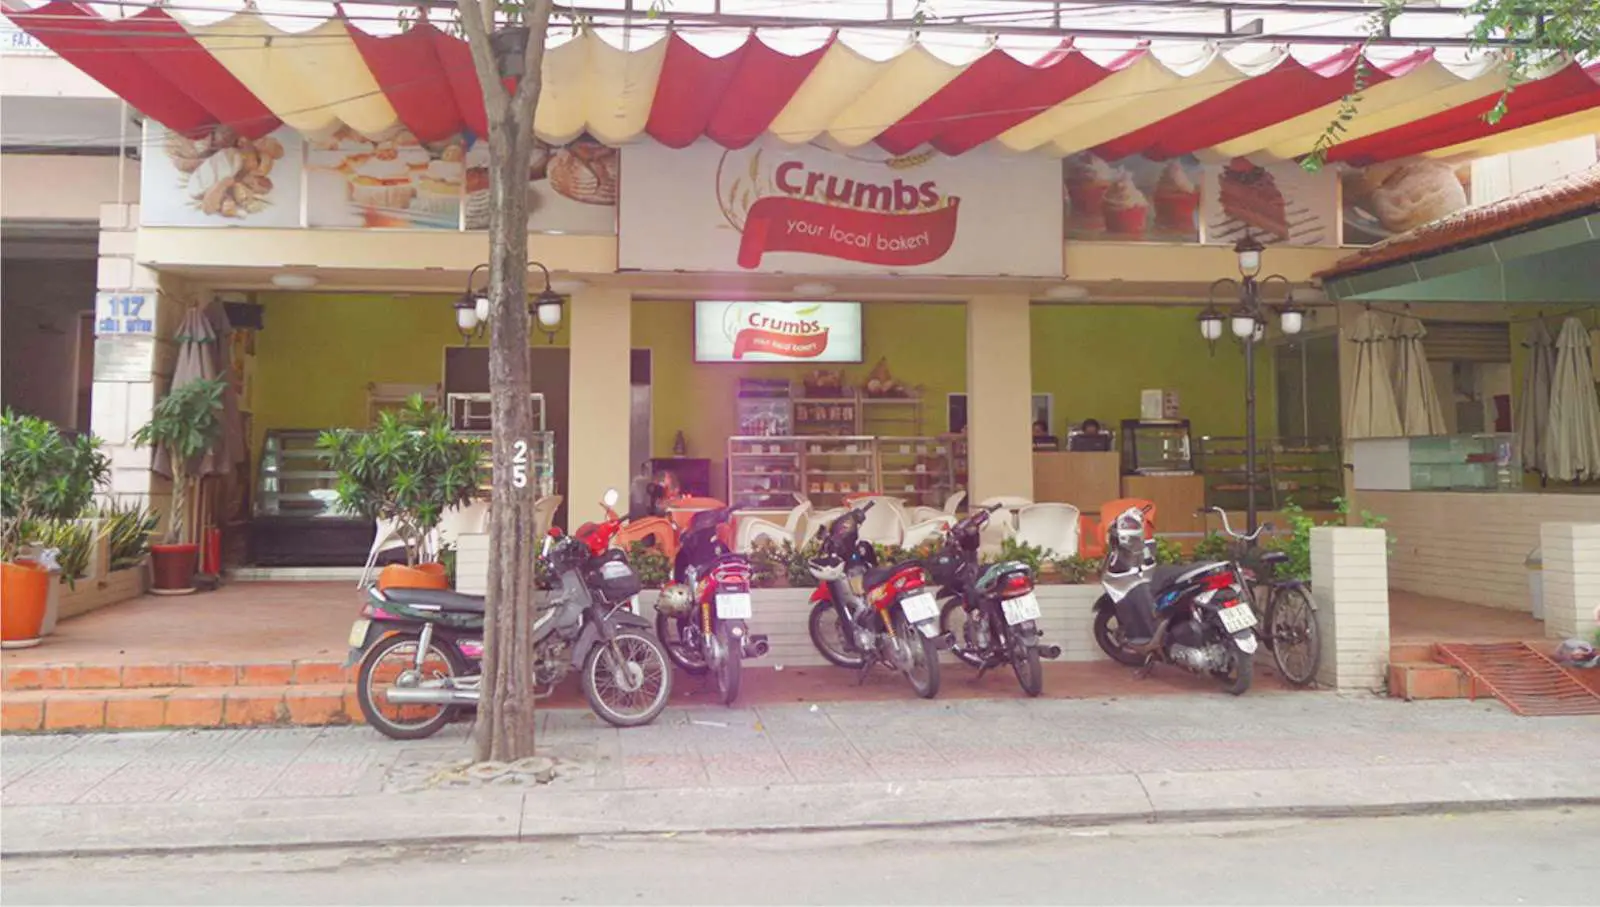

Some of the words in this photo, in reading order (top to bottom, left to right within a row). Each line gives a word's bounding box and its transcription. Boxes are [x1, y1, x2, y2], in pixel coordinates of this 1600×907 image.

[775, 161, 941, 212] Crumbs
[786, 218, 823, 235] your
[829, 227, 871, 248] local
[876, 230, 930, 251] bakery
[108, 296, 145, 316] 117
[748, 312, 820, 334] Crumbs
